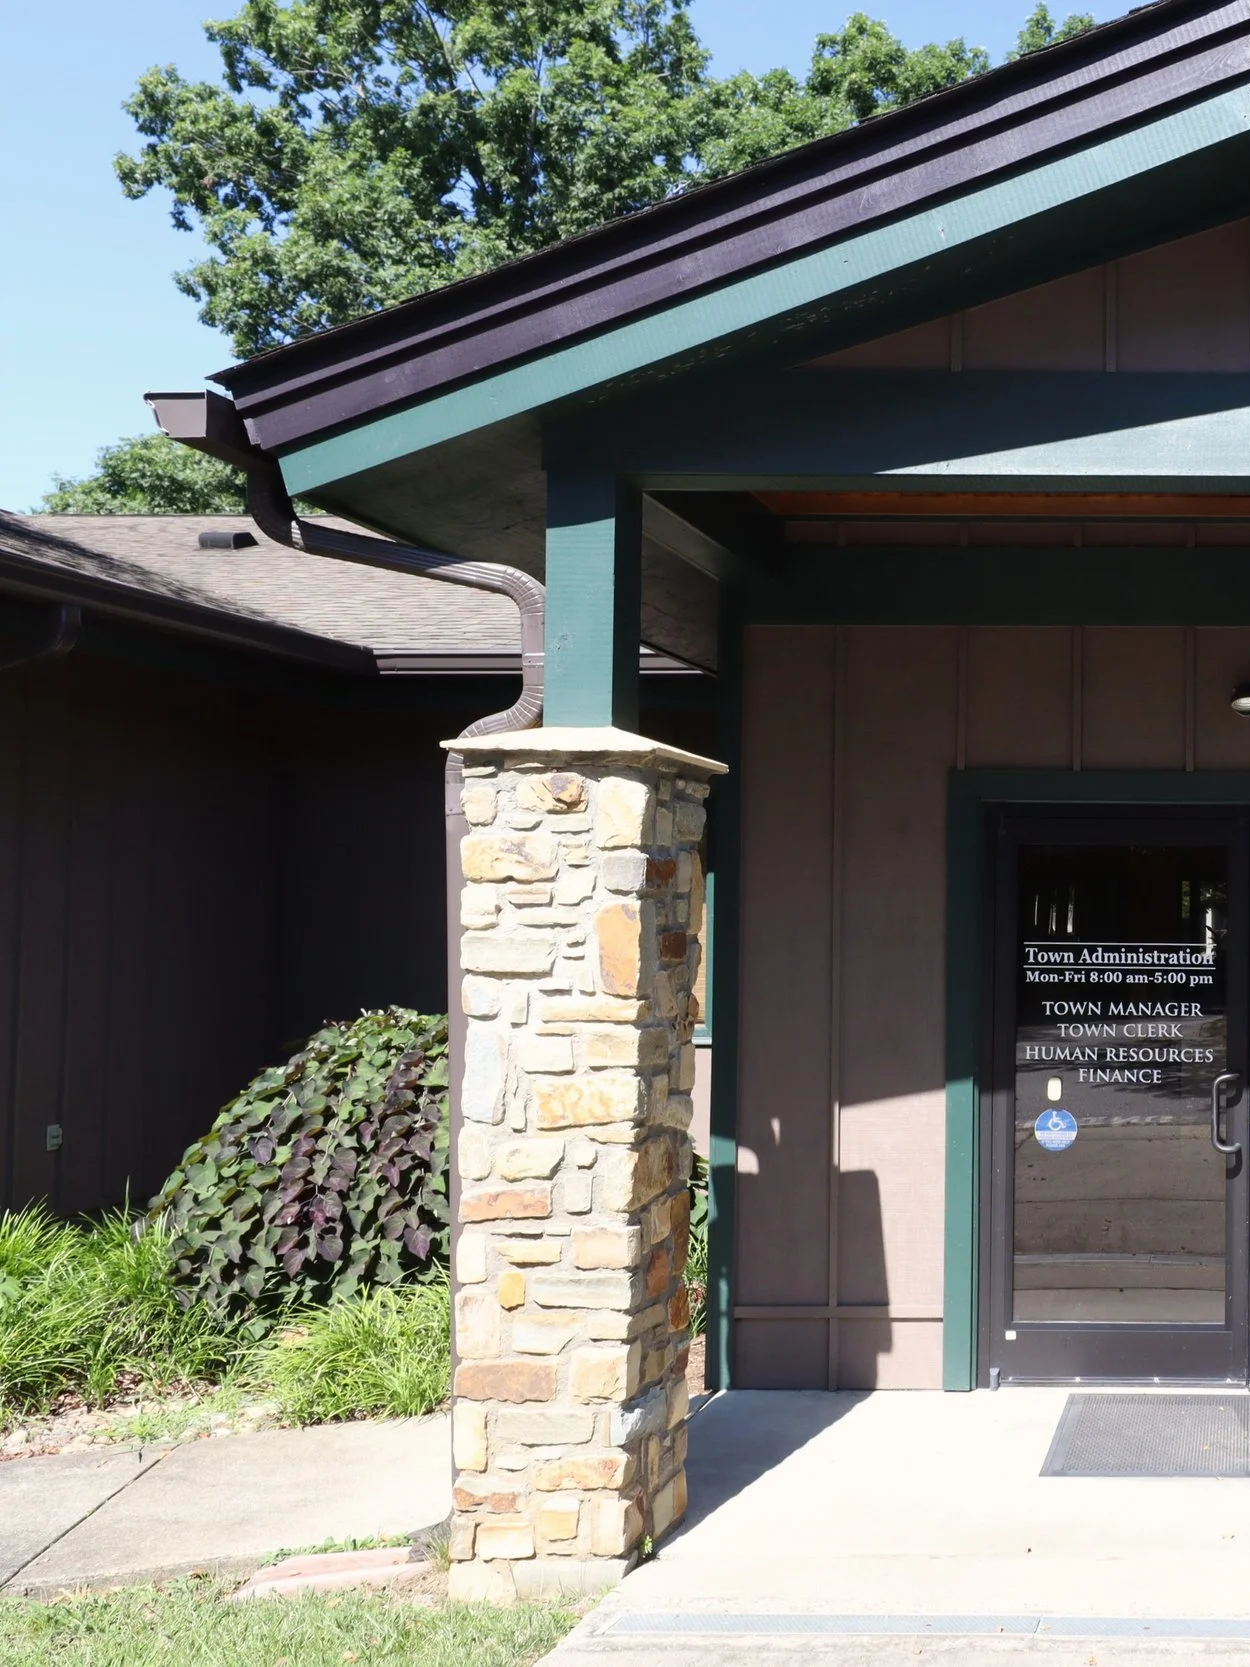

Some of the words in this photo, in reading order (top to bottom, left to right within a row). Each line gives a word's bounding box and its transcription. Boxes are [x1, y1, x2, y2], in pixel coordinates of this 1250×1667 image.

[1025, 947, 1075, 964] Town
[1078, 948, 1214, 965] Administration
[1025, 970, 1086, 983] Mon-Fri
[1089, 971, 1122, 984] 8:00
[1125, 972, 1186, 984] am-5:00
[1189, 974, 1213, 987] pm
[1041, 1001, 1101, 1016] TOWN
[1108, 1002, 1204, 1017] MANAGER
[1057, 1023, 1116, 1038] TOWN
[1123, 1023, 1183, 1038] CLERK
[1025, 1046, 1098, 1061] HUMAN
[1105, 1047, 1214, 1063] RESOURCES
[1078, 1068, 1162, 1084] FINANCE
